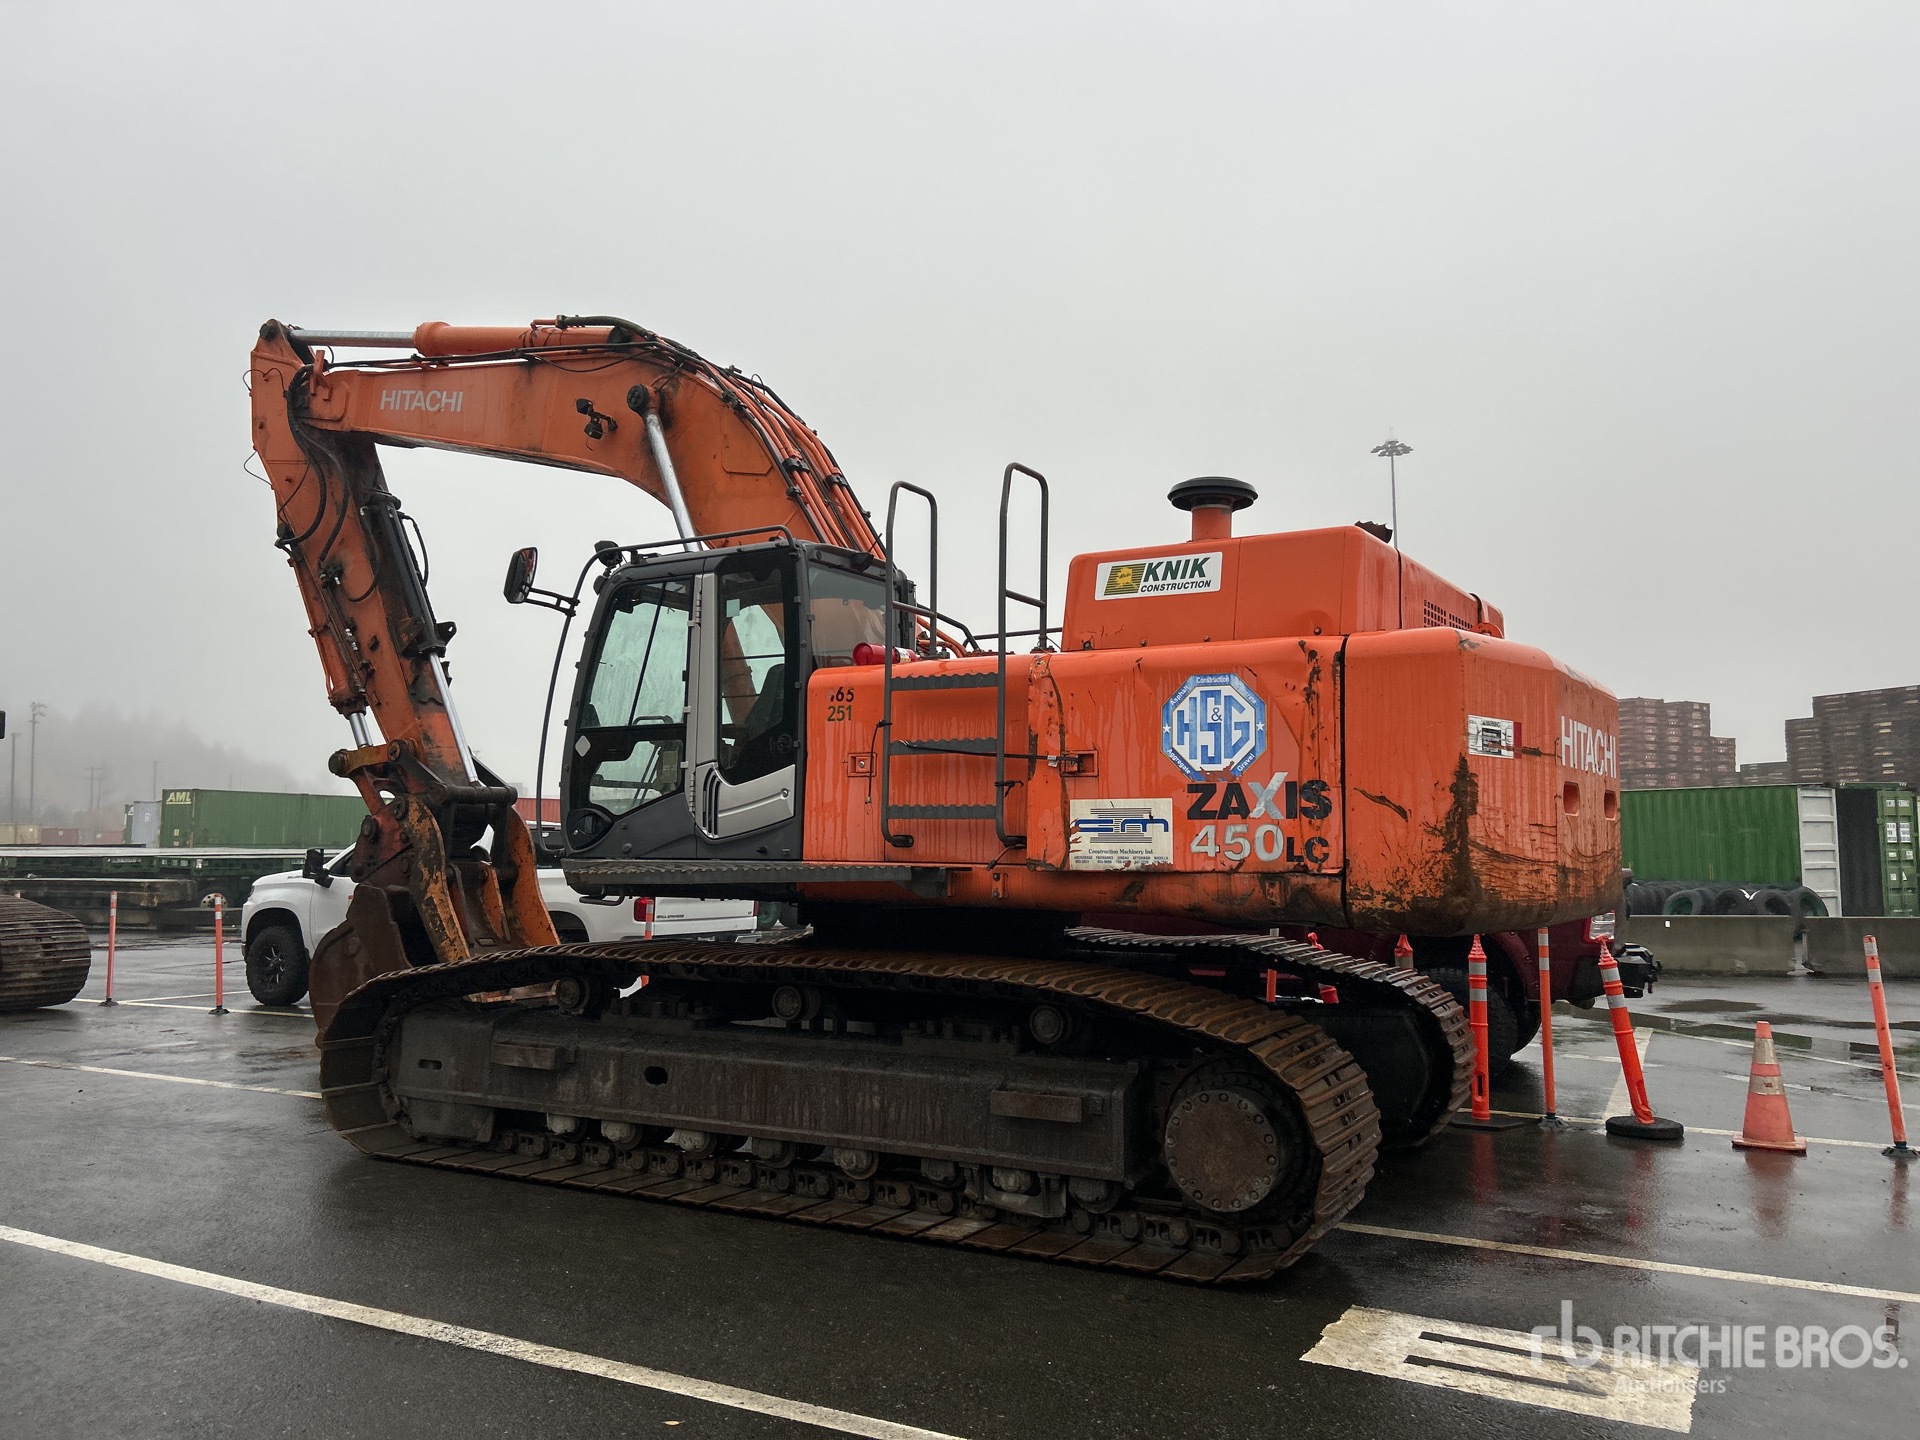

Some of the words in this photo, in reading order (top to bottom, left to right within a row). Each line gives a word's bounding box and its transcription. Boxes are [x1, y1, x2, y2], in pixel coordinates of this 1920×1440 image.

[380, 389, 464, 412] HITACHI
[1143, 557, 1211, 582] KNIK
[1140, 580, 1212, 593] CONSTRUCTION
[1196, 676, 1230, 685] Construction
[1170, 685, 1190, 706] Asphalt
[827, 705, 853, 721] 251
[1561, 715, 1617, 779] HITACHI
[1166, 748, 1192, 776] Aggregate
[1236, 753, 1256, 772] Gravel
[166, 792, 192, 802] AML
[1186, 771, 1333, 820] ZAXIS
[1120, 848, 1144, 856] Machinery
